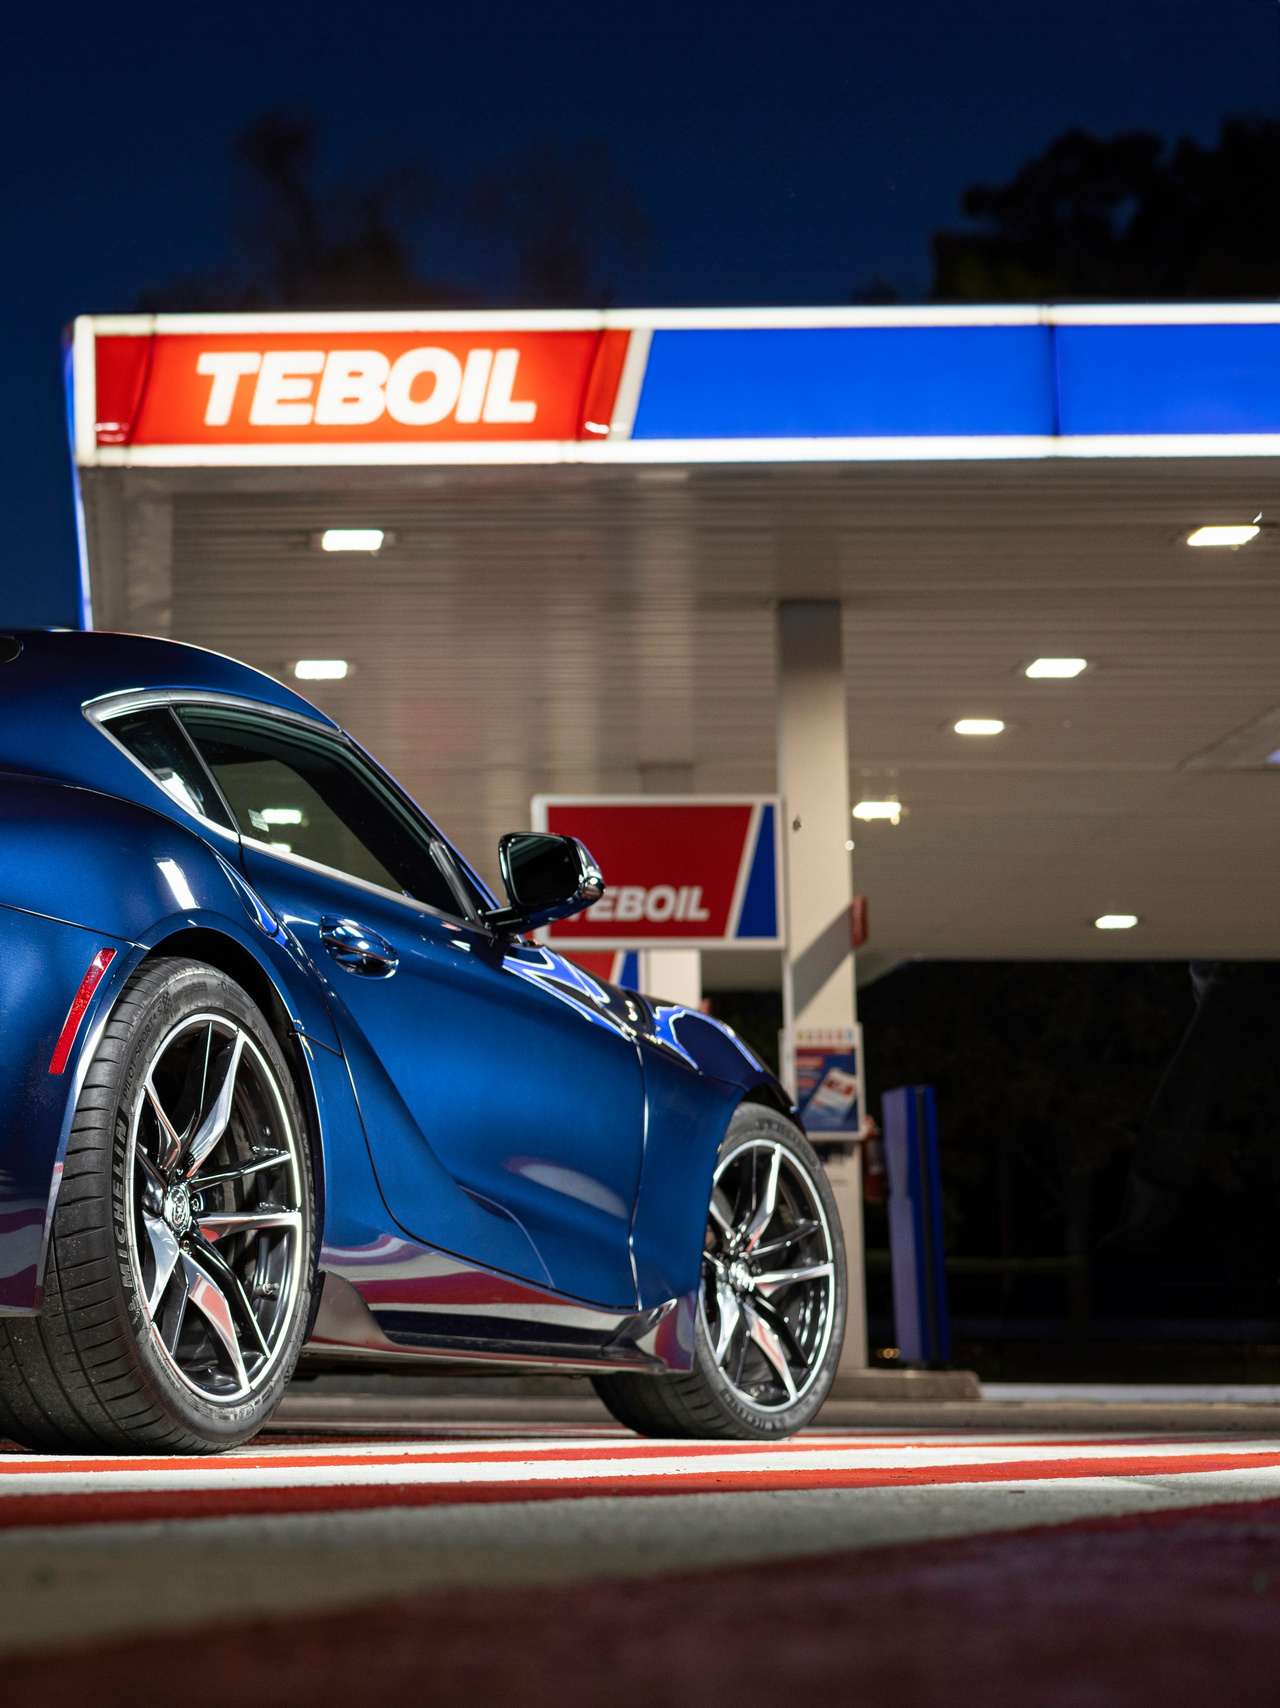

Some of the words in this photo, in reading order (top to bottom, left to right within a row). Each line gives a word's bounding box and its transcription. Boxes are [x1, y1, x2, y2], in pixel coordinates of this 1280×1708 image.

[196, 346, 537, 426] TEBOIL
[568, 884, 710, 922] EBOIL
[122, 1060, 137, 1100] PILOT
[135, 1017, 154, 1058] SPORT
[113, 1117, 134, 1288] MICHELIN
[302, 1133, 316, 1286] MICHELIN
